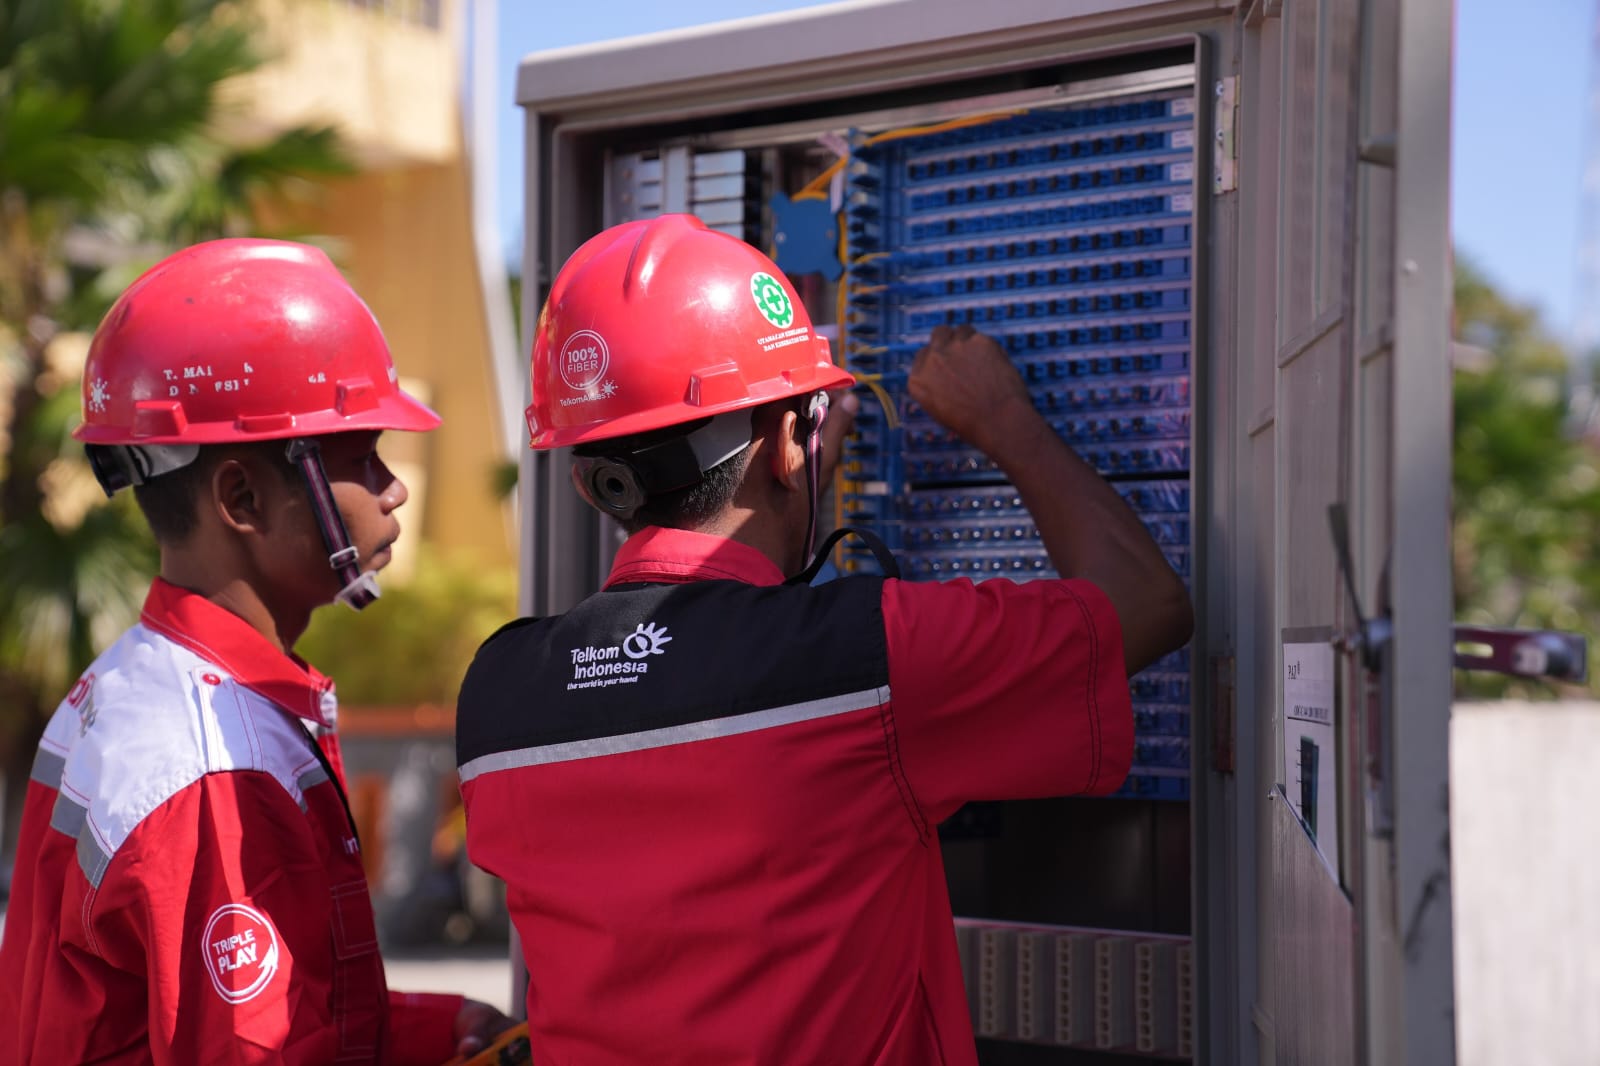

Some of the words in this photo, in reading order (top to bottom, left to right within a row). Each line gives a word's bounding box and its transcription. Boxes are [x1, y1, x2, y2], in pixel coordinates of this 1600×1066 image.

[567, 346, 599, 363] 100%
[567, 361, 599, 374] FIBER
[570, 646, 620, 665] Telkom
[574, 661, 648, 679] Indonesia
[578, 680, 597, 689] world
[619, 675, 639, 684] hand
[212, 929, 255, 955] TRIPLE
[218, 943, 257, 975] PLAY
